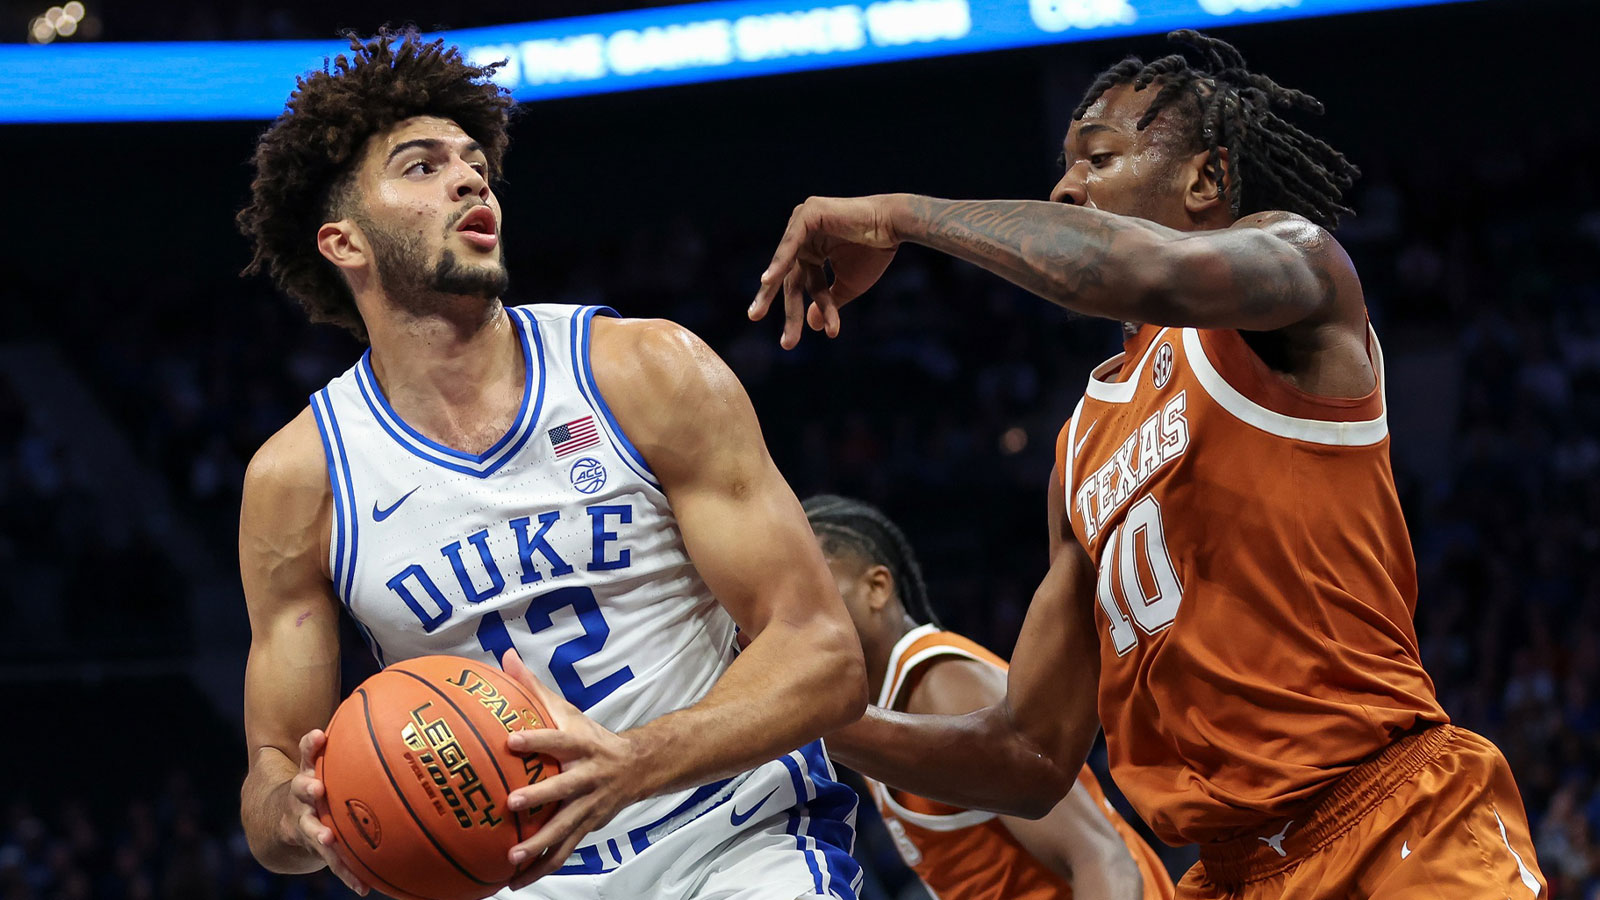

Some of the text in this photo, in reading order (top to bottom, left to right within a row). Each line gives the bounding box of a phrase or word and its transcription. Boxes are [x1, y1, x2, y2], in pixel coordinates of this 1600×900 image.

[1154, 344, 1173, 388] SEC
[576, 465, 602, 481] ACC
[1076, 389, 1190, 545] TEXAS
[386, 504, 633, 633] DUKE
[1097, 492, 1183, 657] 10
[476, 586, 635, 712] 12
[409, 700, 503, 828] LEGACY
[418, 750, 473, 829] 1000
